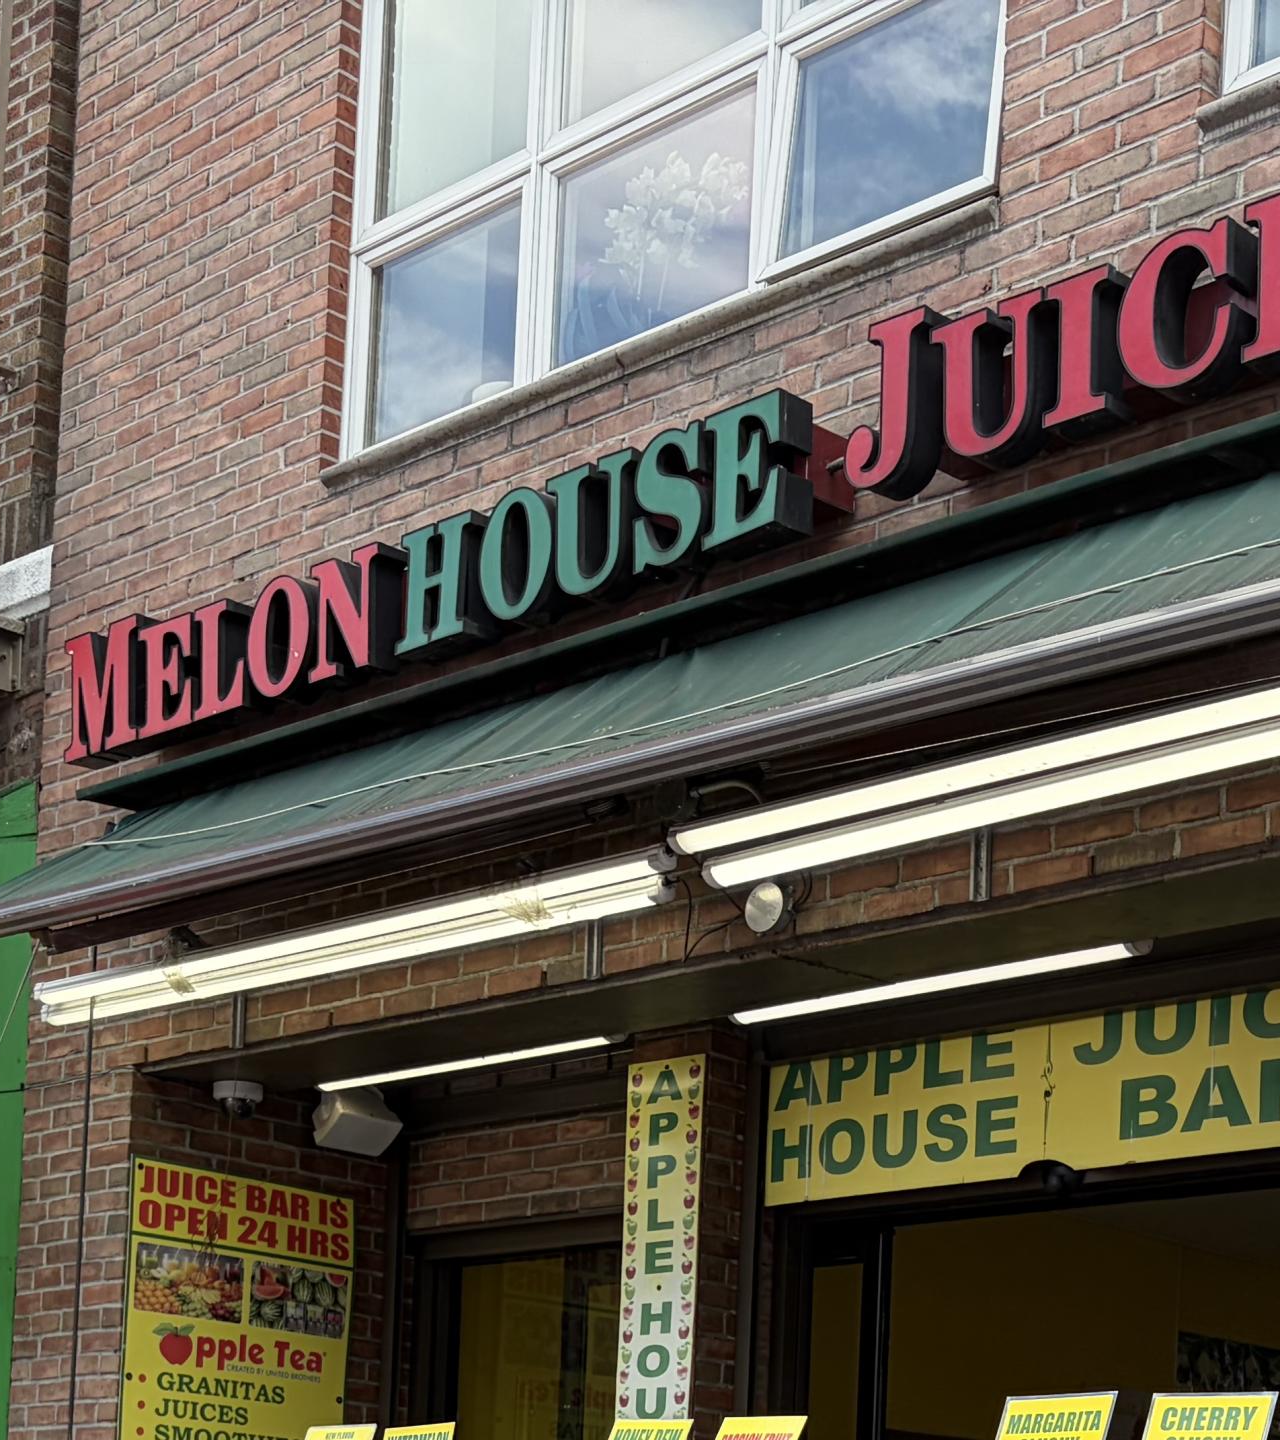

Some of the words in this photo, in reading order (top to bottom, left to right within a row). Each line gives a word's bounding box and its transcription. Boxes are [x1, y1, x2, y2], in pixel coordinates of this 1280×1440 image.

[64, 541, 384, 764] MELON
[394, 387, 783, 657] HOUSE
[774, 1029, 1016, 1111] APPLE
[770, 1096, 1018, 1182] HOUSE
[644, 1066, 683, 1275] APPLE
[140, 1165, 237, 1208] JUICE
[246, 1184, 310, 1221] BAR
[319, 1198, 349, 1229] IS
[139, 1199, 228, 1240] OPEN
[237, 1216, 278, 1248] 24
[287, 1225, 349, 1261] HRS
[226, 1363, 256, 1374] CREATED
[266, 1369, 290, 1379] UNITED
[274, 1340, 324, 1374] Tea
[155, 1399, 249, 1425] JUICES
[157, 1372, 285, 1404] GRANITAS
[1006, 1410, 1102, 1435] MARGARITA
[1160, 1406, 1259, 1431] CHERRY
